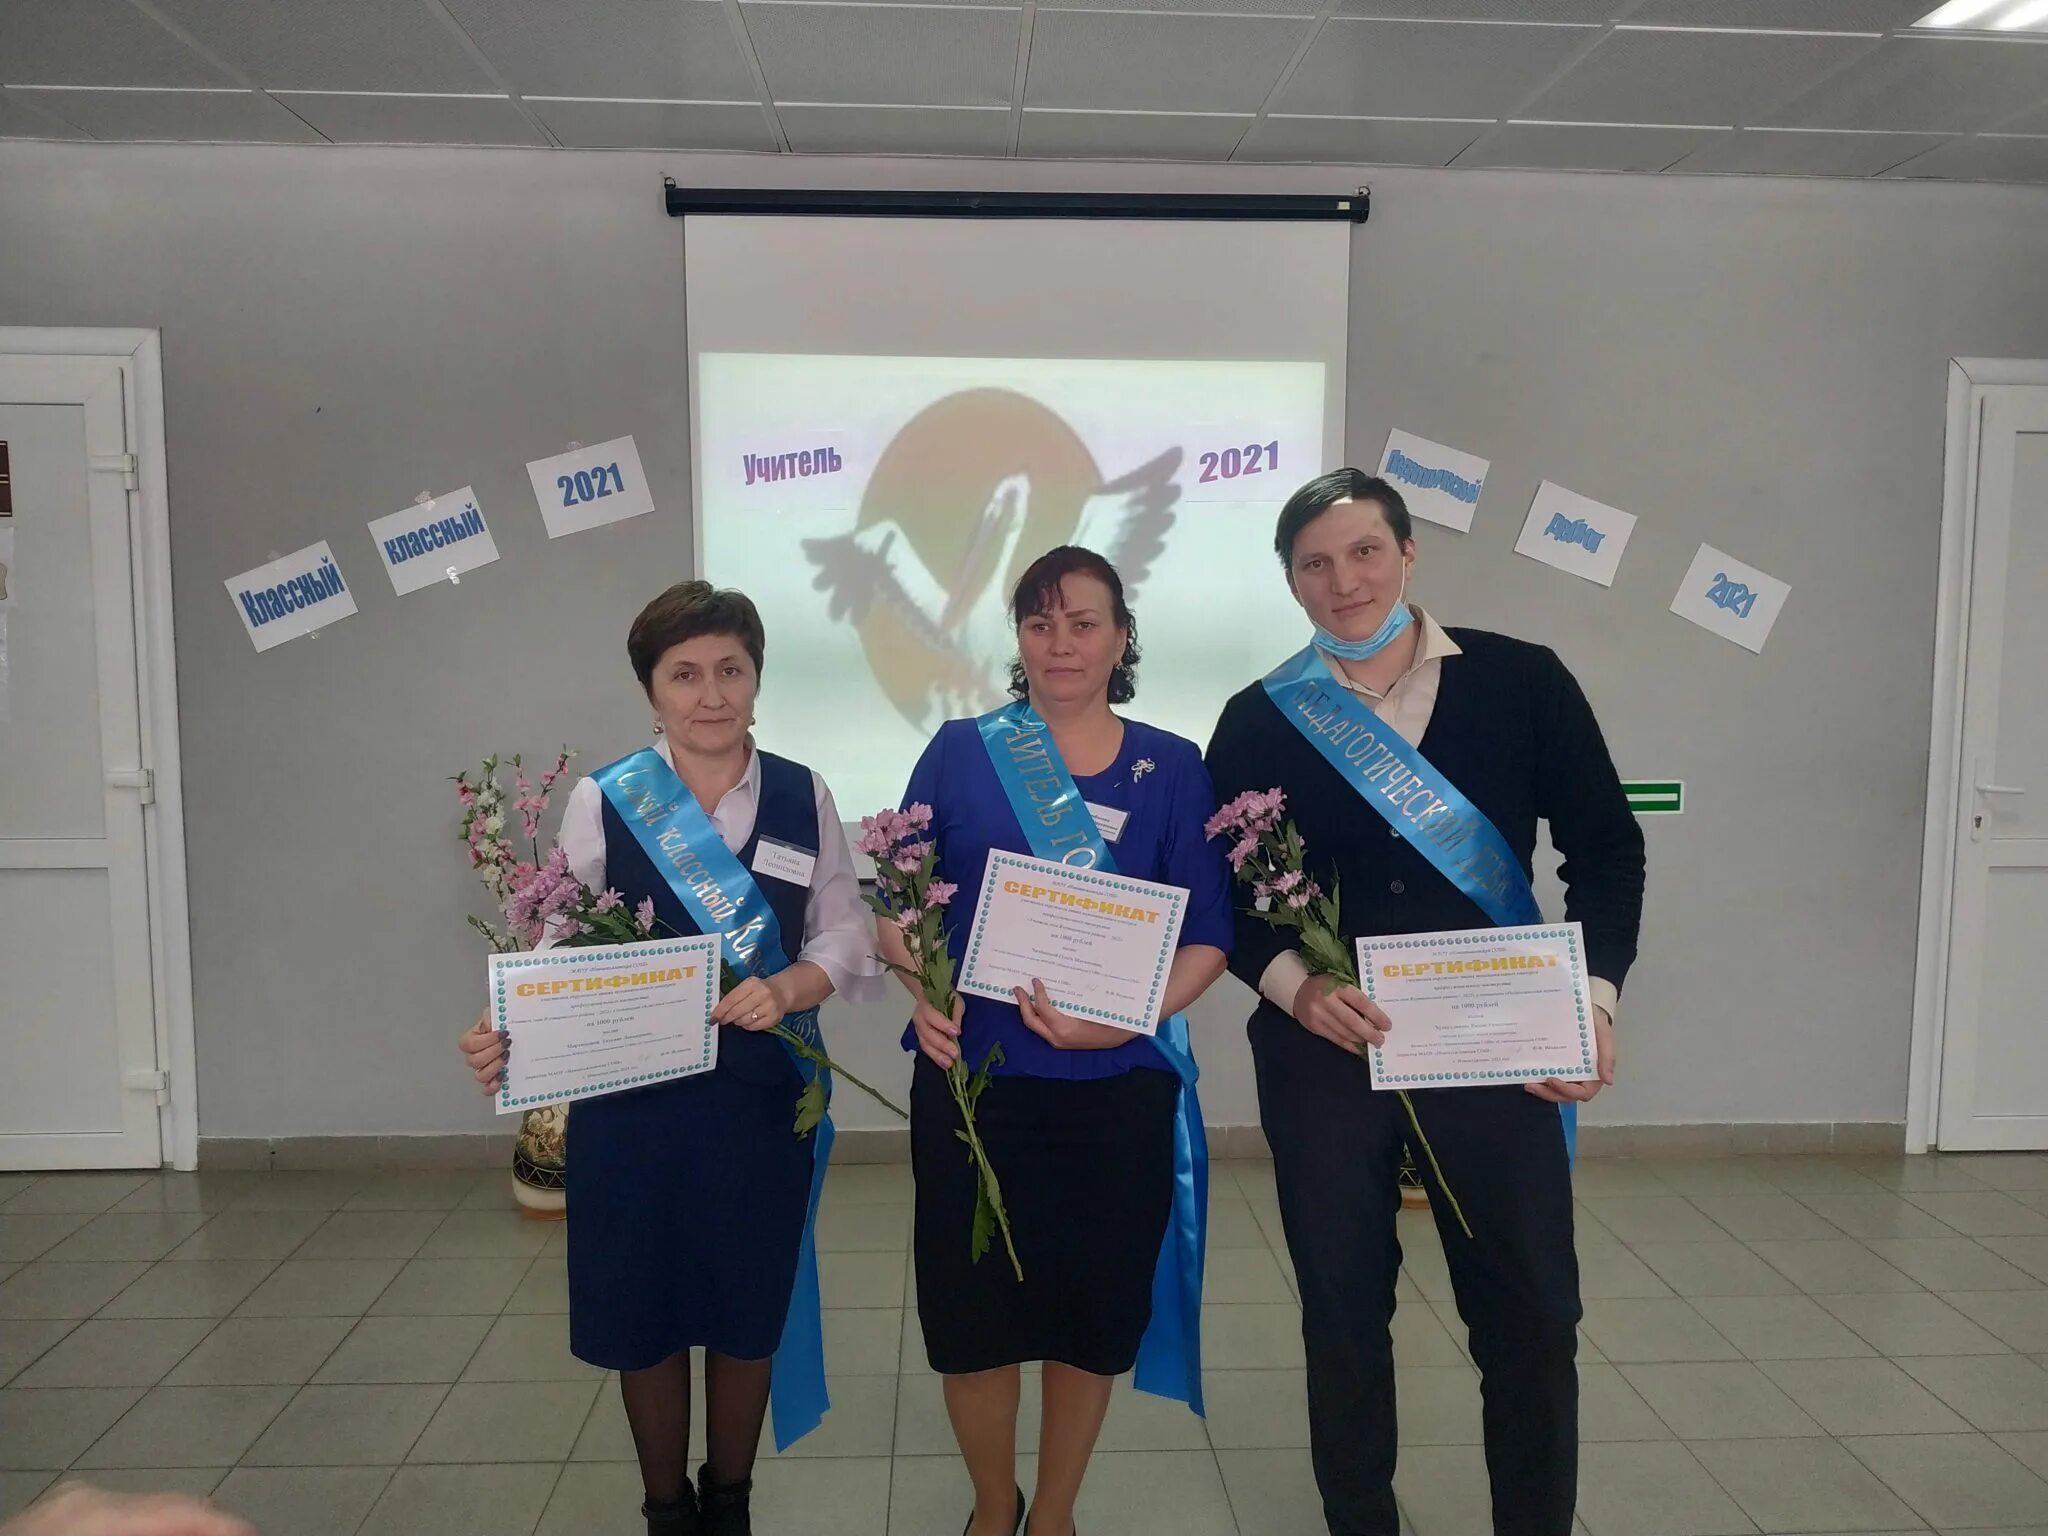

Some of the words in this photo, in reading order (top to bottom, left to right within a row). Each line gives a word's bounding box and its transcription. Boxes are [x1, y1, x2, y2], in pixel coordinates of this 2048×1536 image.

[743, 446, 842, 485] Учитель
[1198, 440, 1280, 484] 2021
[557, 462, 625, 508] 2021
[384, 502, 485, 566] классный
[239, 556, 346, 628] Классный
[1705, 572, 1758, 618] 2021
[1291, 681, 1480, 852] ПЕДАГОГИЧЕСКИЙ
[656, 826, 745, 924] классный
[772, 850, 801, 866] Татьяна
[1003, 880, 1160, 924] СЕРТИФИКАТ
[516, 965, 698, 997] СЕРТИФИКАТ
[1382, 954, 1560, 979] СЕРТИФИКАТ
